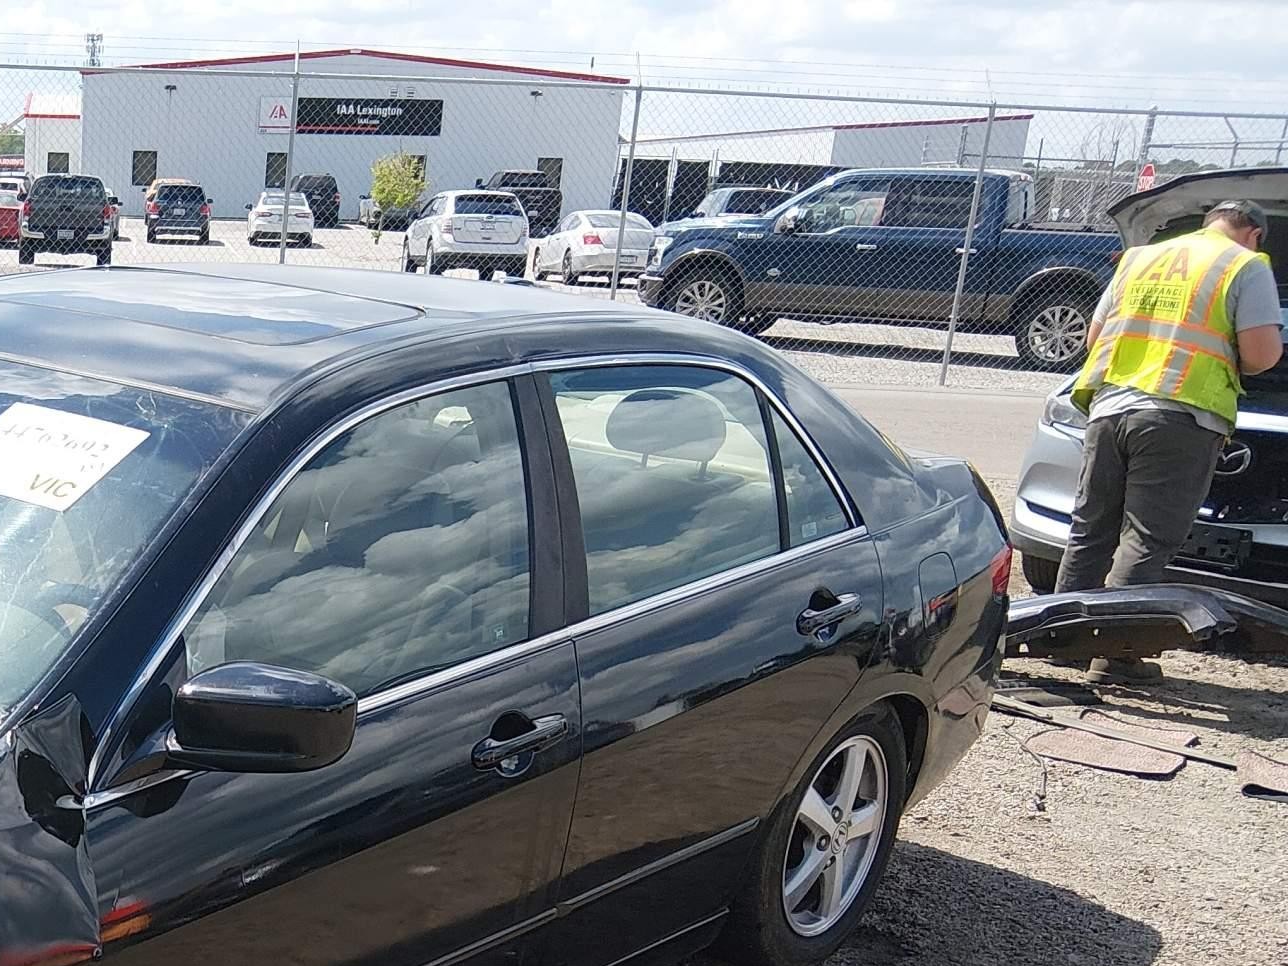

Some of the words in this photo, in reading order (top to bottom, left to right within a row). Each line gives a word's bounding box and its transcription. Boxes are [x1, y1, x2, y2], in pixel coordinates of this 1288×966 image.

[336, 105, 354, 115] IAA
[357, 105, 402, 117] Lexington
[1131, 287, 1184, 296] INSURANCE
[30, 473, 77, 498] VIC
